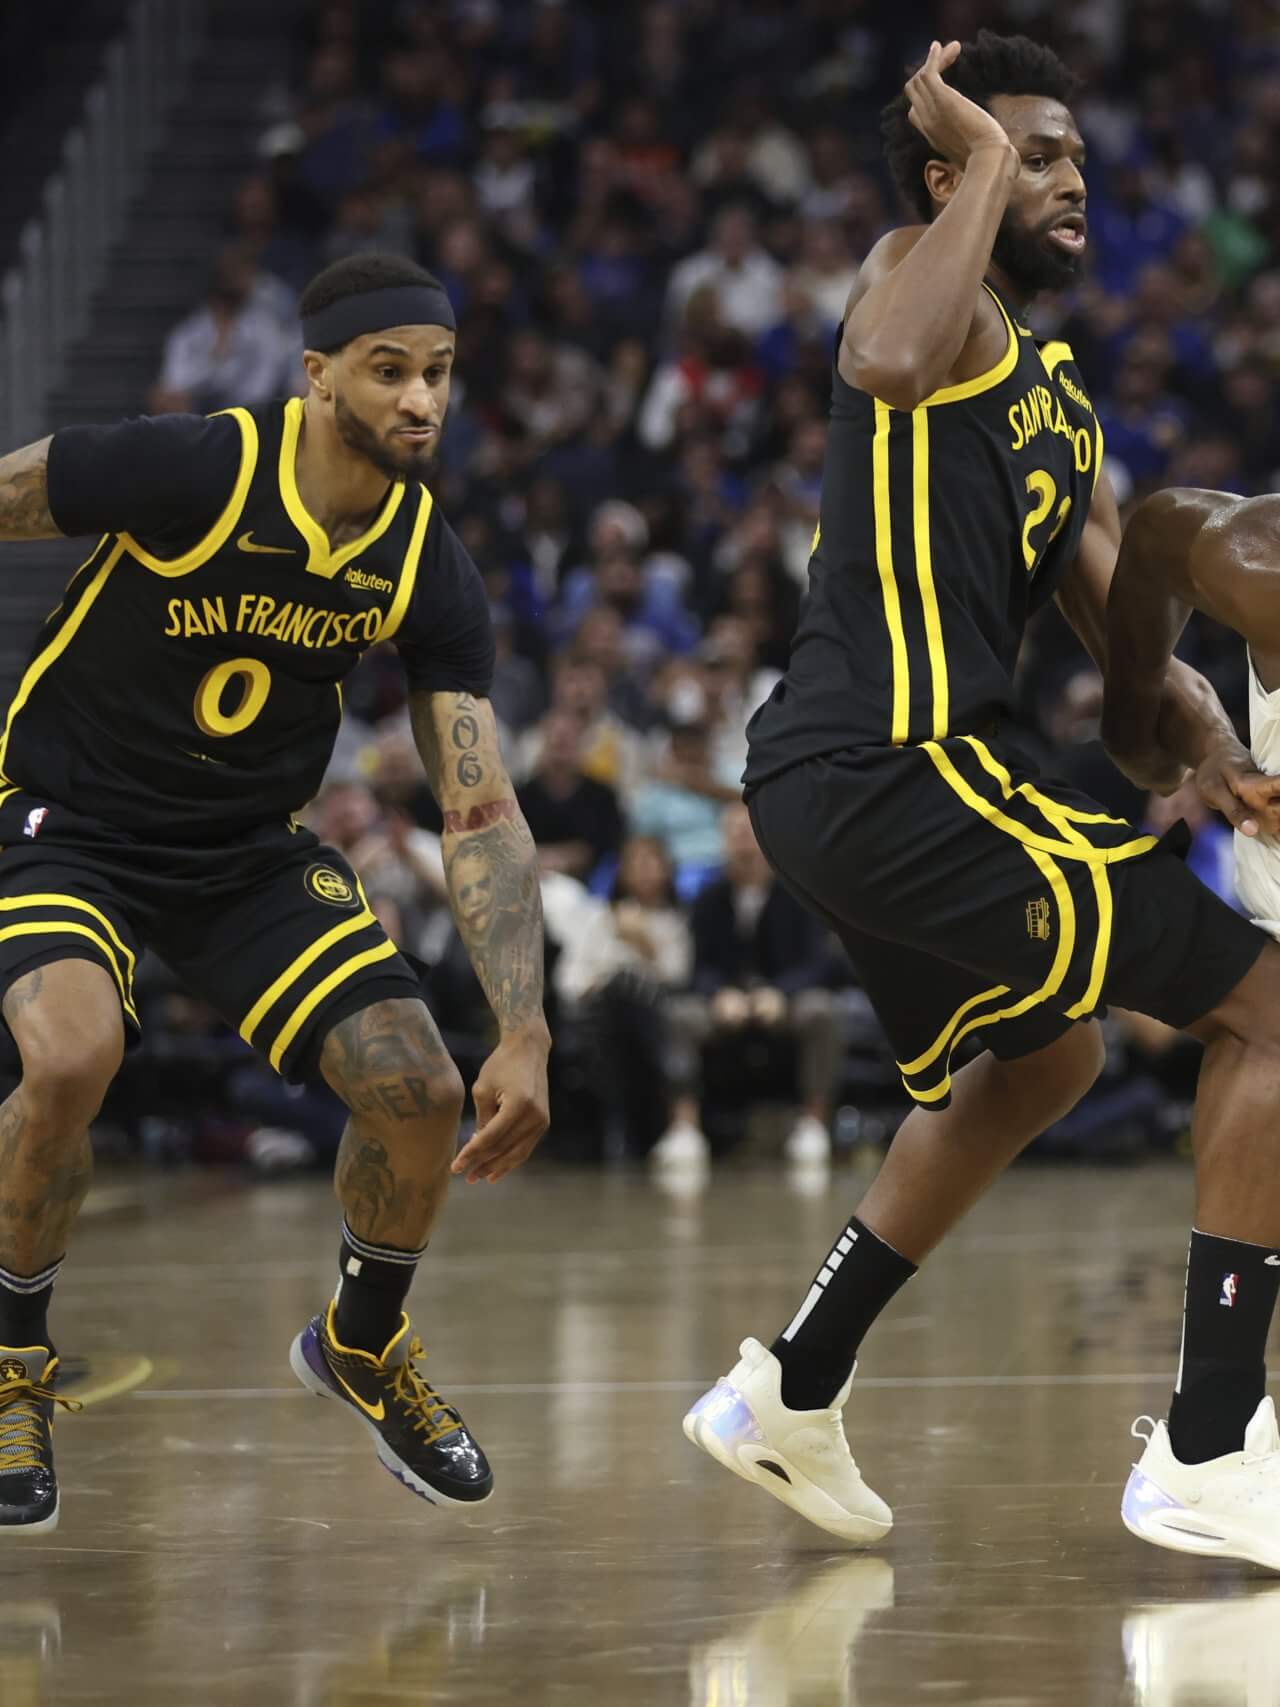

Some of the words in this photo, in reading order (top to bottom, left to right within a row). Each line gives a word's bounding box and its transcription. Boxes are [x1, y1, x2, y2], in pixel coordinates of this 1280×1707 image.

[165, 597, 228, 638] SAN
[236, 594, 383, 648] FRANCISCO
[193, 657, 272, 738] 0
